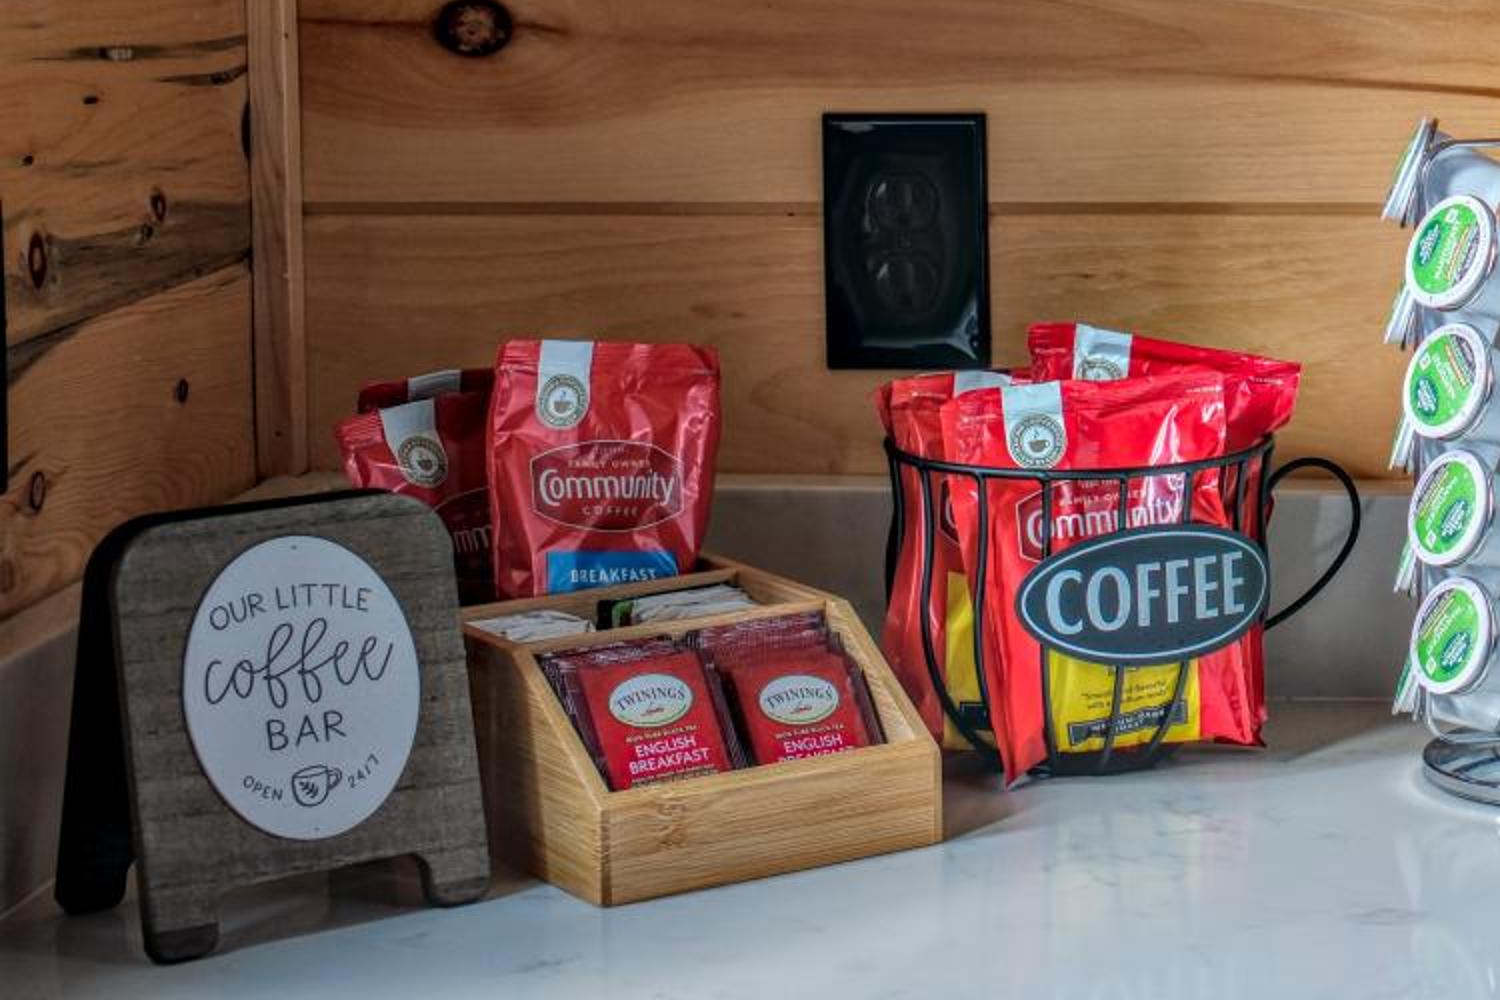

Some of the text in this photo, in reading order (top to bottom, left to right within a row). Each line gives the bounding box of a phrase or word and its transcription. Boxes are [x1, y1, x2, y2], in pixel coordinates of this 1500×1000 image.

[538, 468, 676, 507] Community
[581, 505, 639, 517] COFFEE
[570, 567, 658, 584] BREAKFAST
[209, 582, 373, 631] OUR LITTLE
[1045, 551, 1245, 635] COFFEE
[204, 617, 394, 709] coffee
[617, 684, 686, 711] TWININGS
[765, 685, 833, 709] TWININGS
[266, 709, 347, 751] BAR
[783, 732, 843, 754] ENGLISH
[635, 735, 697, 758] ENGLISH
[629, 747, 710, 775] BREAKFAST
[242, 774, 284, 801] OPEN
